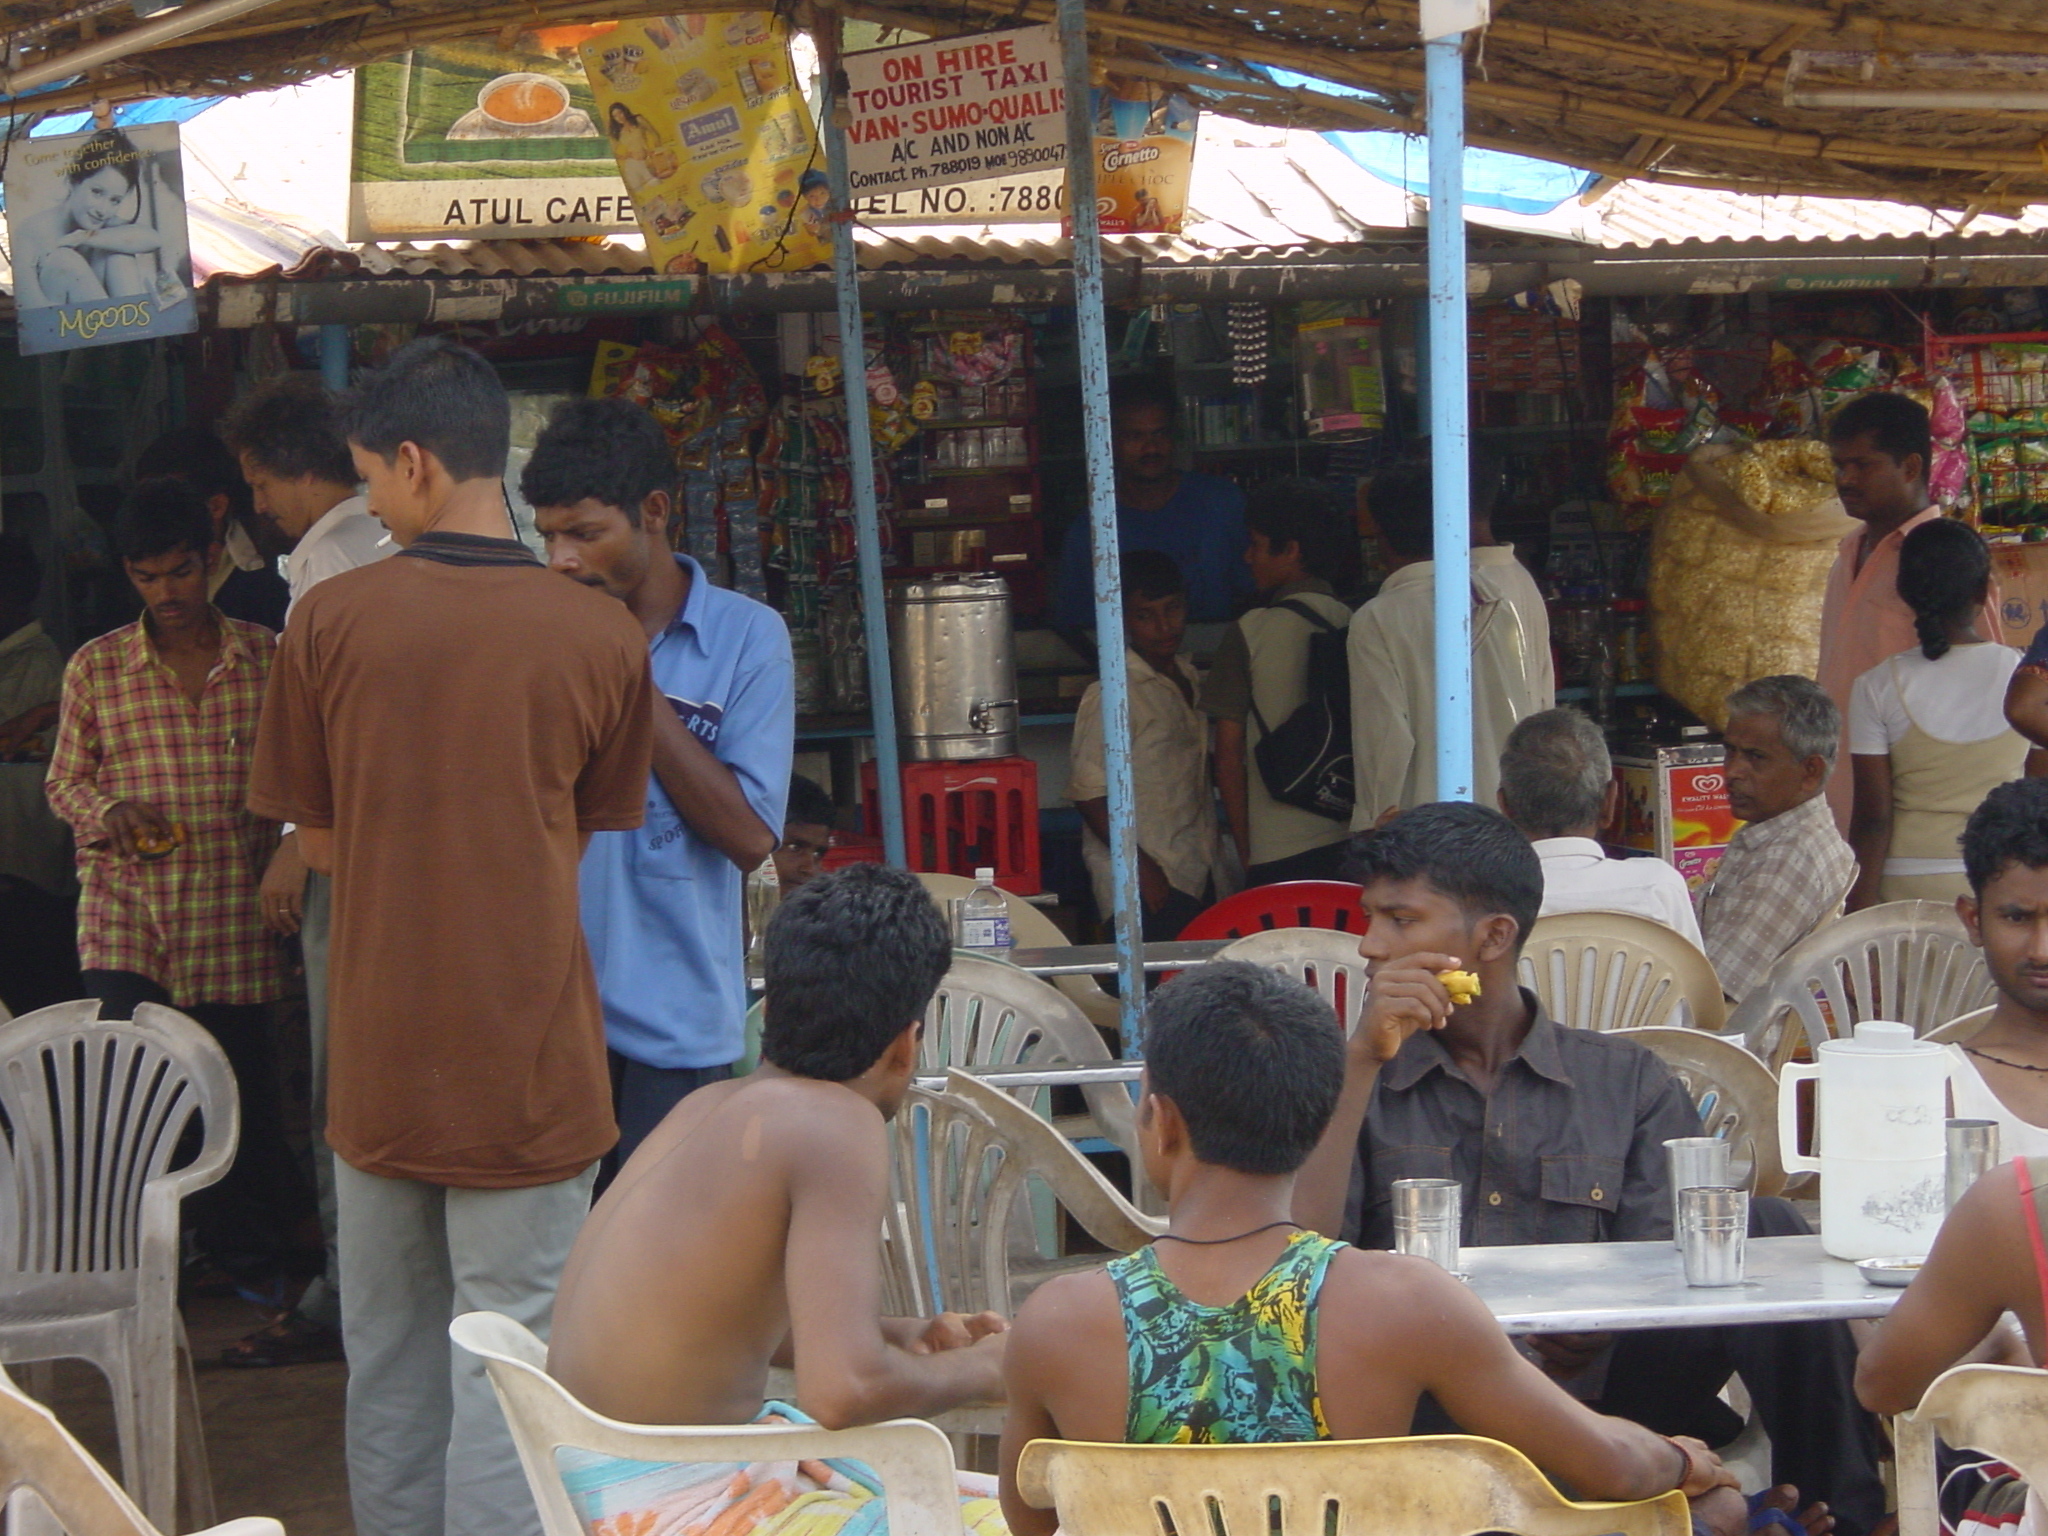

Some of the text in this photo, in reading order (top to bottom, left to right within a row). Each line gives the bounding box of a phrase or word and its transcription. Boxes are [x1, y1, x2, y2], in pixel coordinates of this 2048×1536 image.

[883, 40, 1017, 83] ON HIRE
[852, 61, 1049, 113] TOURIST TAXI
[687, 113, 732, 139] Amul
[24, 139, 116, 167] Come together
[891, 137, 919, 165] A/C
[930, 132, 970, 157] AND
[975, 125, 1010, 149] NON
[54, 162, 81, 177] with
[1104, 147, 1160, 172] Cornetto
[443, 196, 634, 225] ATUL CAFE
[593, 288, 681, 305] FUJIFILM
[1809, 279, 1889, 289] FUJIFILM
[59, 301, 151, 339] MOODS
